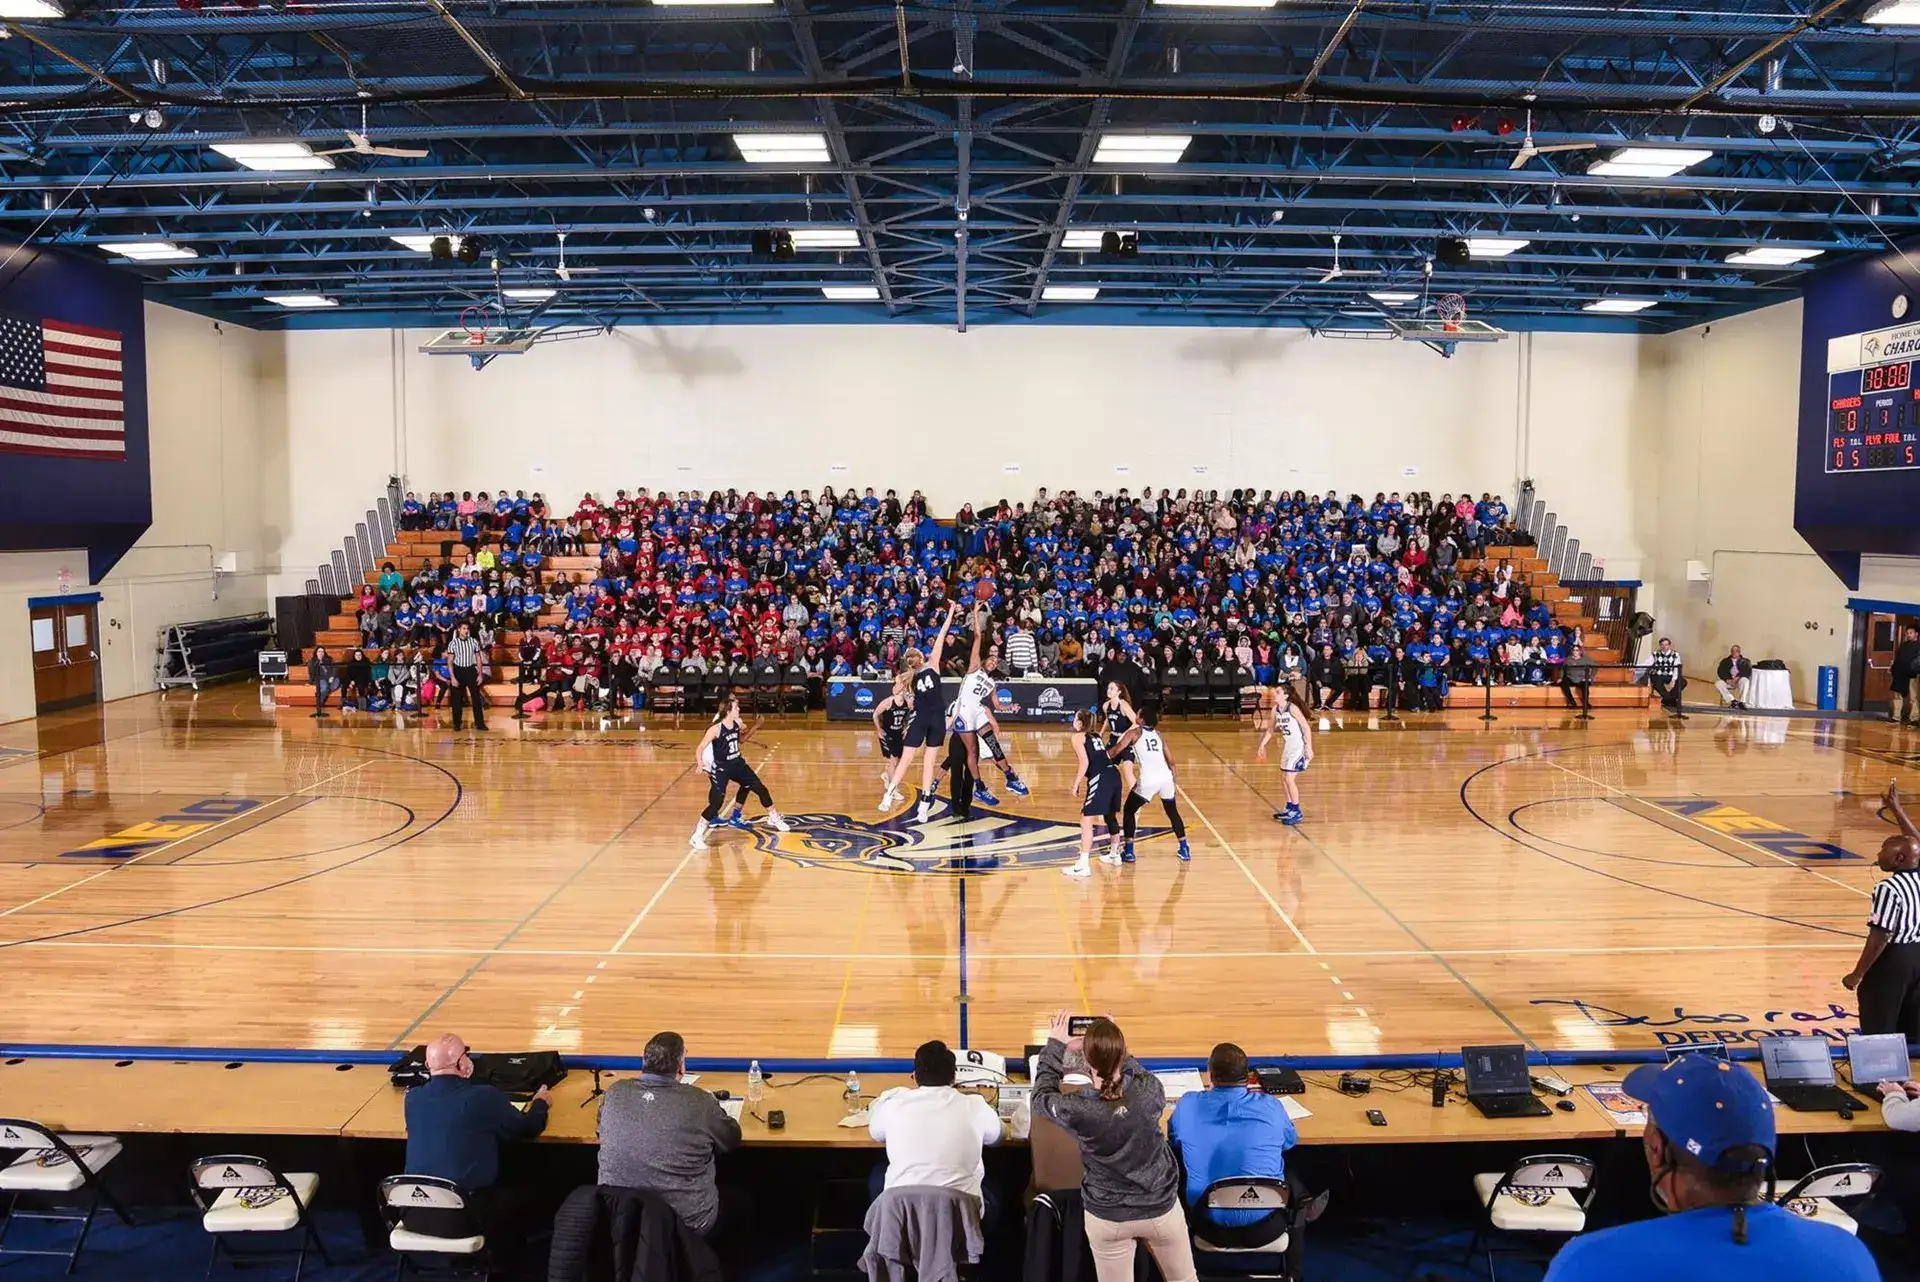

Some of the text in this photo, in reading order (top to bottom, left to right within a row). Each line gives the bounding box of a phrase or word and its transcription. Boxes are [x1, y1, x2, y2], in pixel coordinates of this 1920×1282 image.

[1891, 329, 1912, 341] HOME
[1875, 398, 1894, 407] PERIOD
[1865, 434, 1881, 445] PLYR
[1884, 432, 1901, 444] FOUL
[916, 675, 934, 692] 44
[728, 740, 738, 753] 31
[1145, 739, 1159, 752] 12
[1652, 1027, 1862, 1045] DEBORAH
